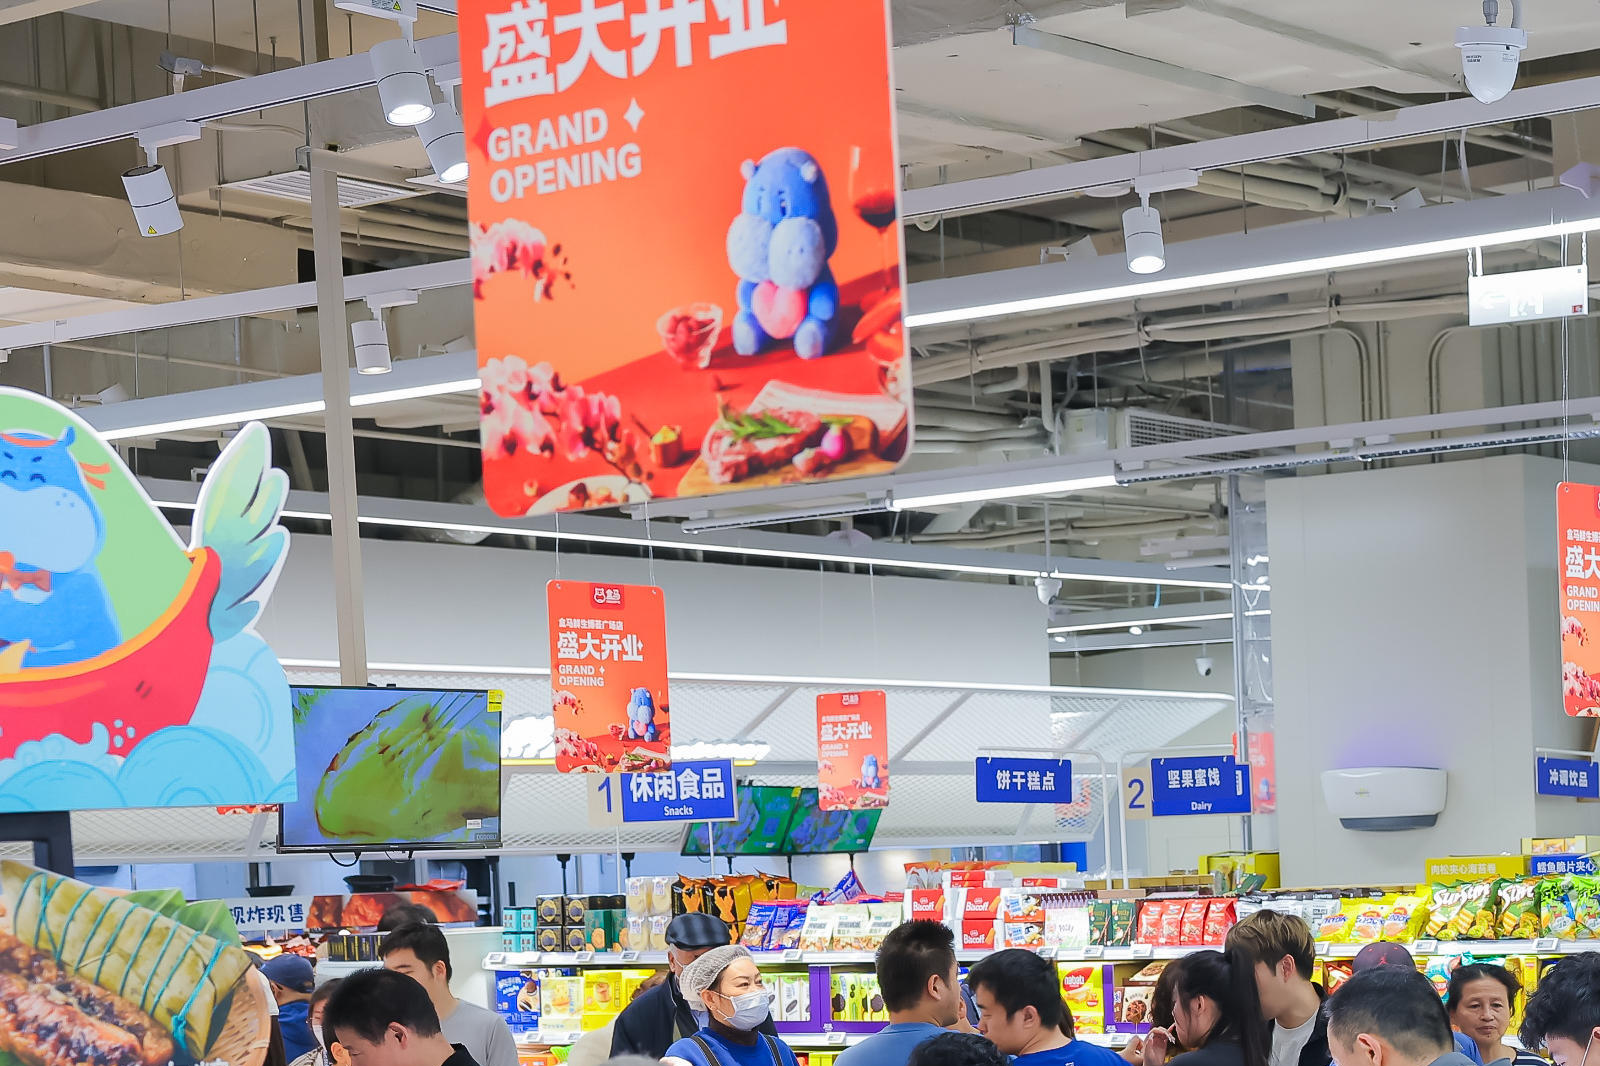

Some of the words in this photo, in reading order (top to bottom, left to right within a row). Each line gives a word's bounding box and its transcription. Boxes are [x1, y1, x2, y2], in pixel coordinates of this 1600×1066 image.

[487, 108, 608, 163] GRAND
[489, 143, 642, 203] OPENING
[1566, 585, 1598, 598] GRAND
[557, 631, 643, 661] 盛大开业
[559, 664, 595, 675] GRAND
[559, 676, 604, 687] OPENING
[821, 721, 872, 741] 盛大开业
[996, 770, 1055, 791] 饼干糕点
[1167, 768, 1221, 789] 坚果蜜饯
[1549, 769, 1588, 788] 冲调饮品
[598, 776, 612, 813] 1
[630, 768, 725, 802] 休闲食品
[1127, 779, 1146, 809] 2
[664, 805, 693, 816] Snacks
[1191, 801, 1213, 812] Dairy
[1431, 863, 1496, 875] 肉松夹心海苔卷
[1537, 861, 1595, 873] 鳕鱼脆片夹心
[1498, 882, 1534, 912] Sun
[913, 902, 935, 912] Biscoff
[966, 902, 989, 912] Biscoff
[963, 934, 985, 944] Biscoff
